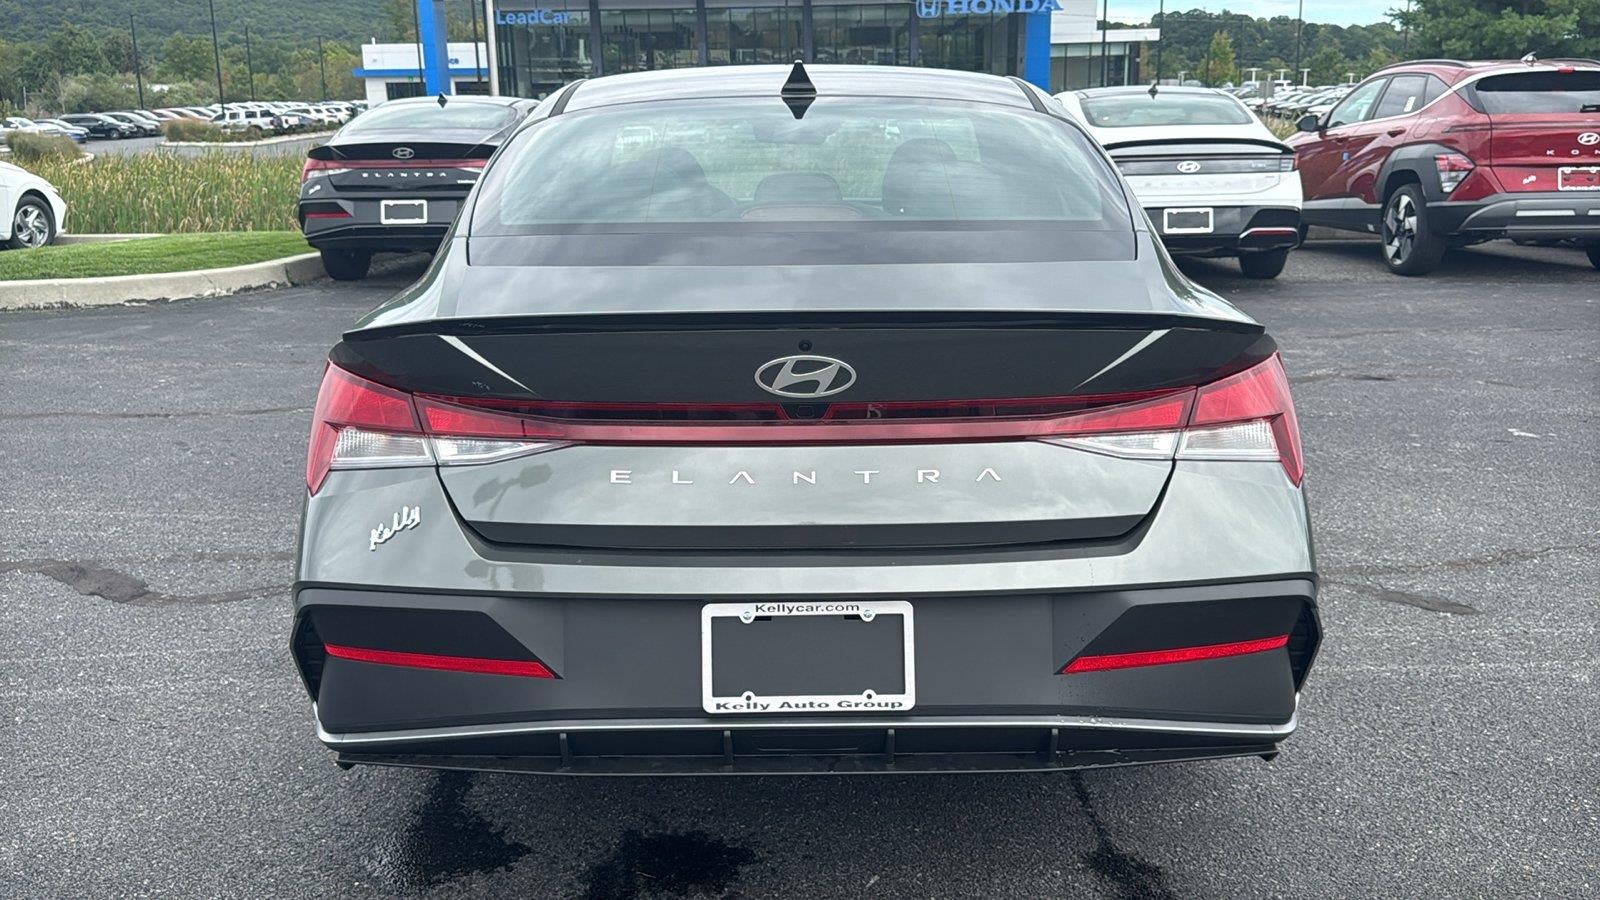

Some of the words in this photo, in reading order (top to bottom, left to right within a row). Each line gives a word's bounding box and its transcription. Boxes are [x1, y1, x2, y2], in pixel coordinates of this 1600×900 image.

[946, 0, 1064, 14] HONDA
[495, 8, 569, 25] LeadCar
[610, 468, 1002, 485] ELANTRA
[369, 506, 421, 552] Kelly
[754, 603, 860, 615] Kellycar.com
[715, 701, 770, 711] Kelly
[778, 700, 830, 710] Auto
[837, 699, 903, 710] Group
